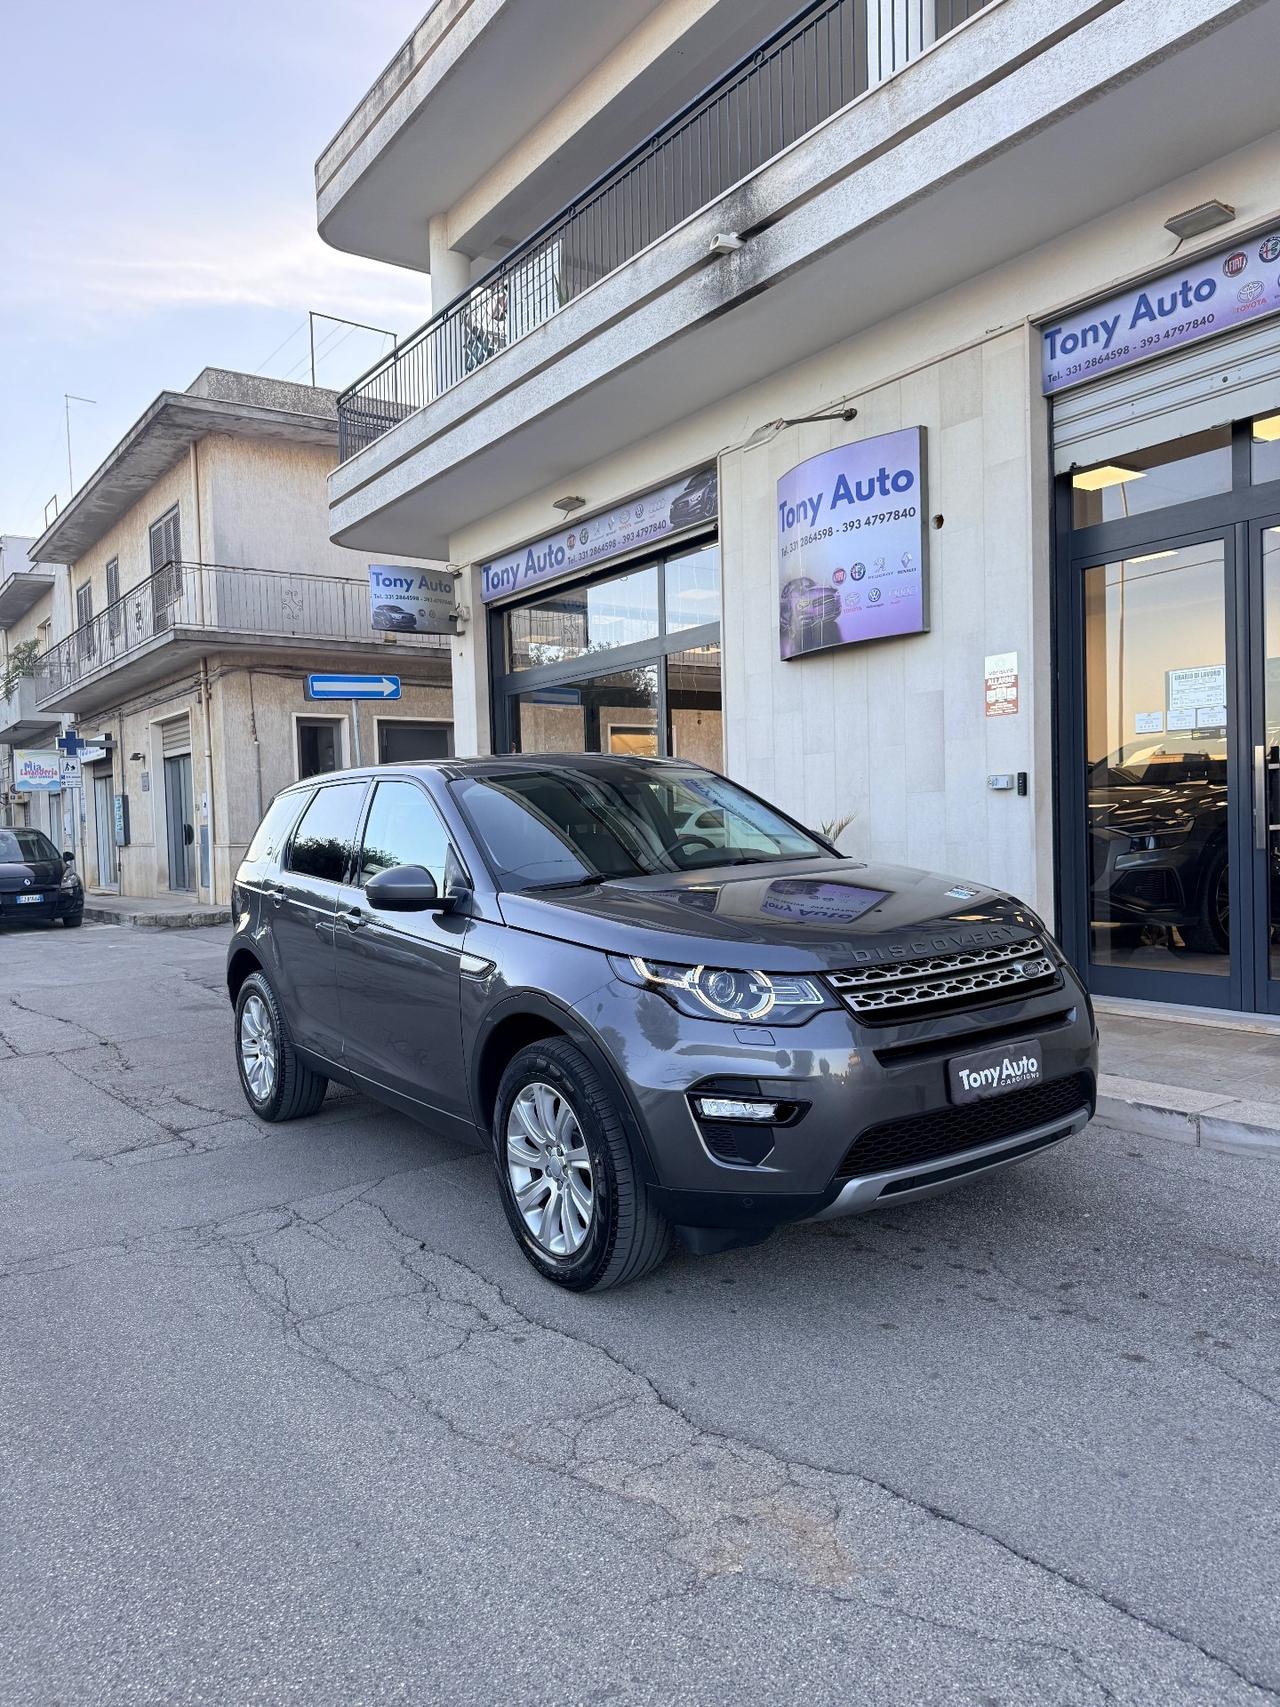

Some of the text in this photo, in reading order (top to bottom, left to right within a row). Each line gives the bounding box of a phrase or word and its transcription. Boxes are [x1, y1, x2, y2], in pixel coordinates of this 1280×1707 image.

[1044, 278, 1217, 360] Tony Auto
[1233, 298, 1267, 313] TOYOTA
[1048, 372, 1063, 383] Tel.
[1066, 364, 1082, 376] 331
[1085, 346, 1130, 370] 2864598
[1140, 334, 1160, 349] 393
[1163, 313, 1215, 339] 4797840
[779, 467, 914, 533] Tony Auto
[579, 550, 588, 561] 331
[590, 539, 617, 556] 2864598
[622, 532, 634, 545] 393
[636, 520, 667, 539] 4797840
[790, 541, 799, 553] 331
[800, 526, 833, 548] 2864598
[842, 519, 861, 533] 393
[864, 506, 916, 527] 4797840
[372, 572, 452, 593] Tony Auto
[483, 544, 565, 593] Tony Auto
[1174, 673, 1193, 681] ORARIO
[1201, 670, 1221, 678] LAVORO
[20, 767, 58, 776] Lavanderia
[24, 761, 41, 771] Mia
[852, 927, 1015, 962] DISCOVERY
